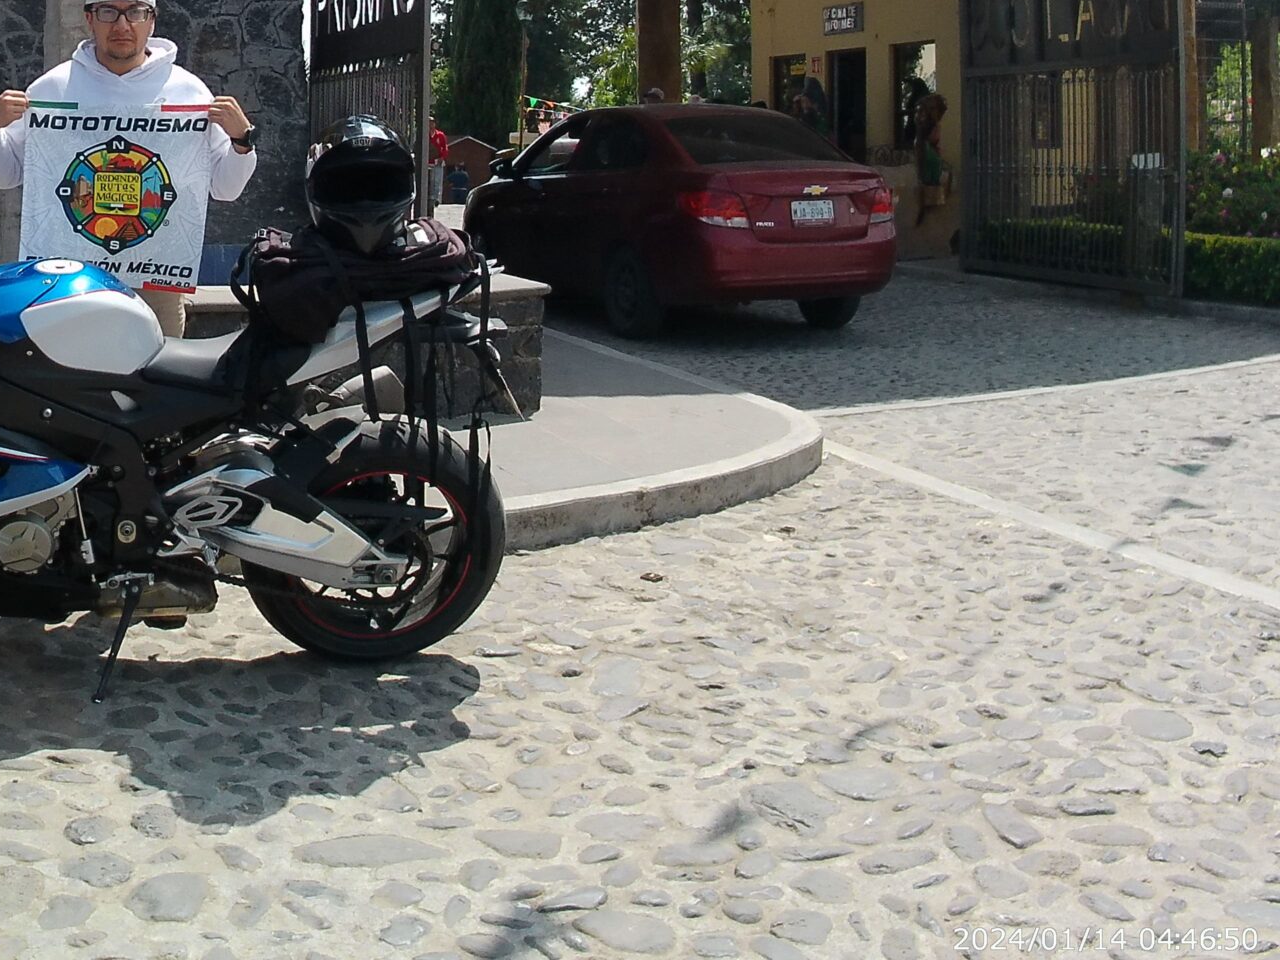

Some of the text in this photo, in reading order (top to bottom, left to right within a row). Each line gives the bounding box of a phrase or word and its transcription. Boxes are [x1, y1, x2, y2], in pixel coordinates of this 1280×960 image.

[29, 113, 209, 133] MOTOTURISMO
[112, 141, 125, 150] N
[163, 191, 174, 201] E
[109, 240, 120, 250] S
[126, 259, 193, 279] MÉXICO
